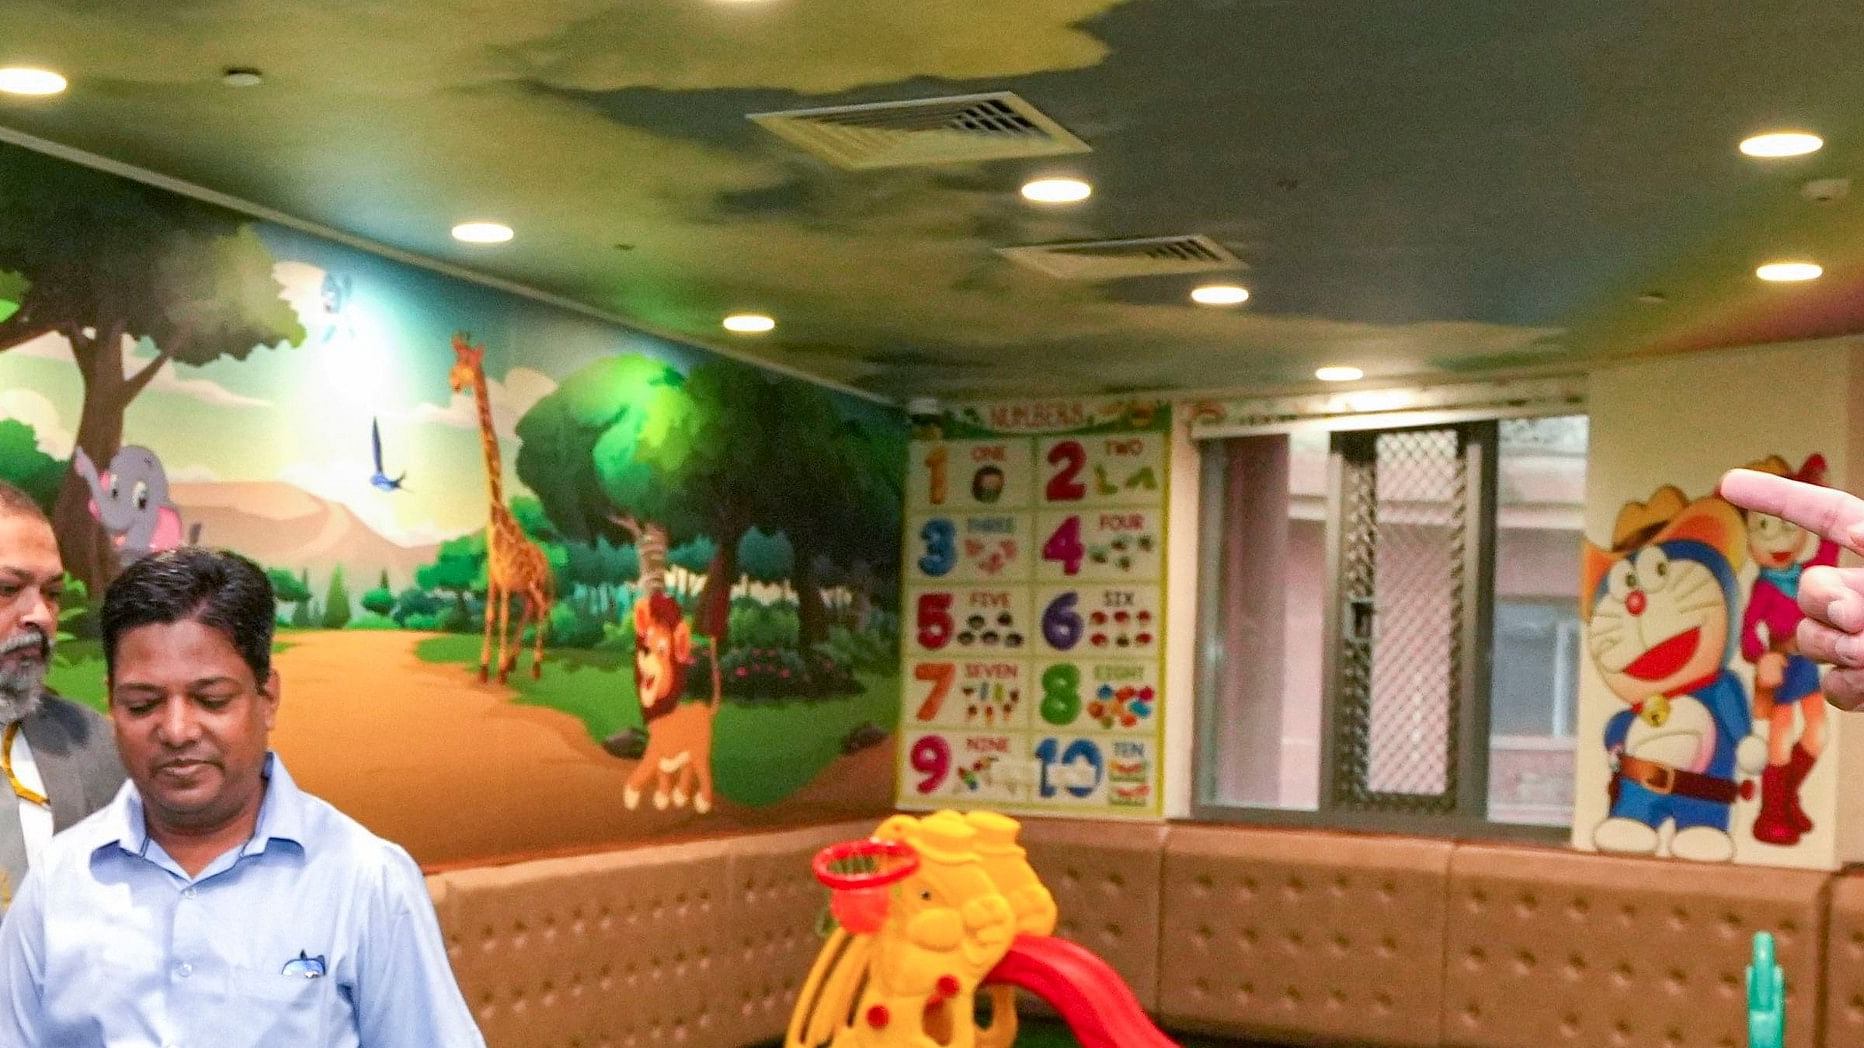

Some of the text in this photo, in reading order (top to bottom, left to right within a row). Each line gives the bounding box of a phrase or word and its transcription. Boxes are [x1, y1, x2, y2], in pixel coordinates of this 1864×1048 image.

[925, 446, 949, 505] 1
[971, 446, 1007, 462] ONE
[1046, 440, 1087, 502] 2
[1105, 439, 1143, 456] TWO
[918, 518, 957, 577] 3
[1042, 515, 1085, 575] 4
[1100, 514, 1145, 532] FOUR
[917, 593, 954, 650] 5
[969, 593, 1011, 609] FIVE
[1041, 591, 1084, 651] 6
[1103, 591, 1134, 607] SIX
[914, 663, 955, 721] 7
[965, 663, 1018, 679] SEVEN
[1040, 663, 1081, 726] 8
[911, 735, 951, 794] 9
[966, 737, 1010, 754] NINE
[1035, 737, 1104, 798] 10
[1112, 741, 1144, 757] TEN
